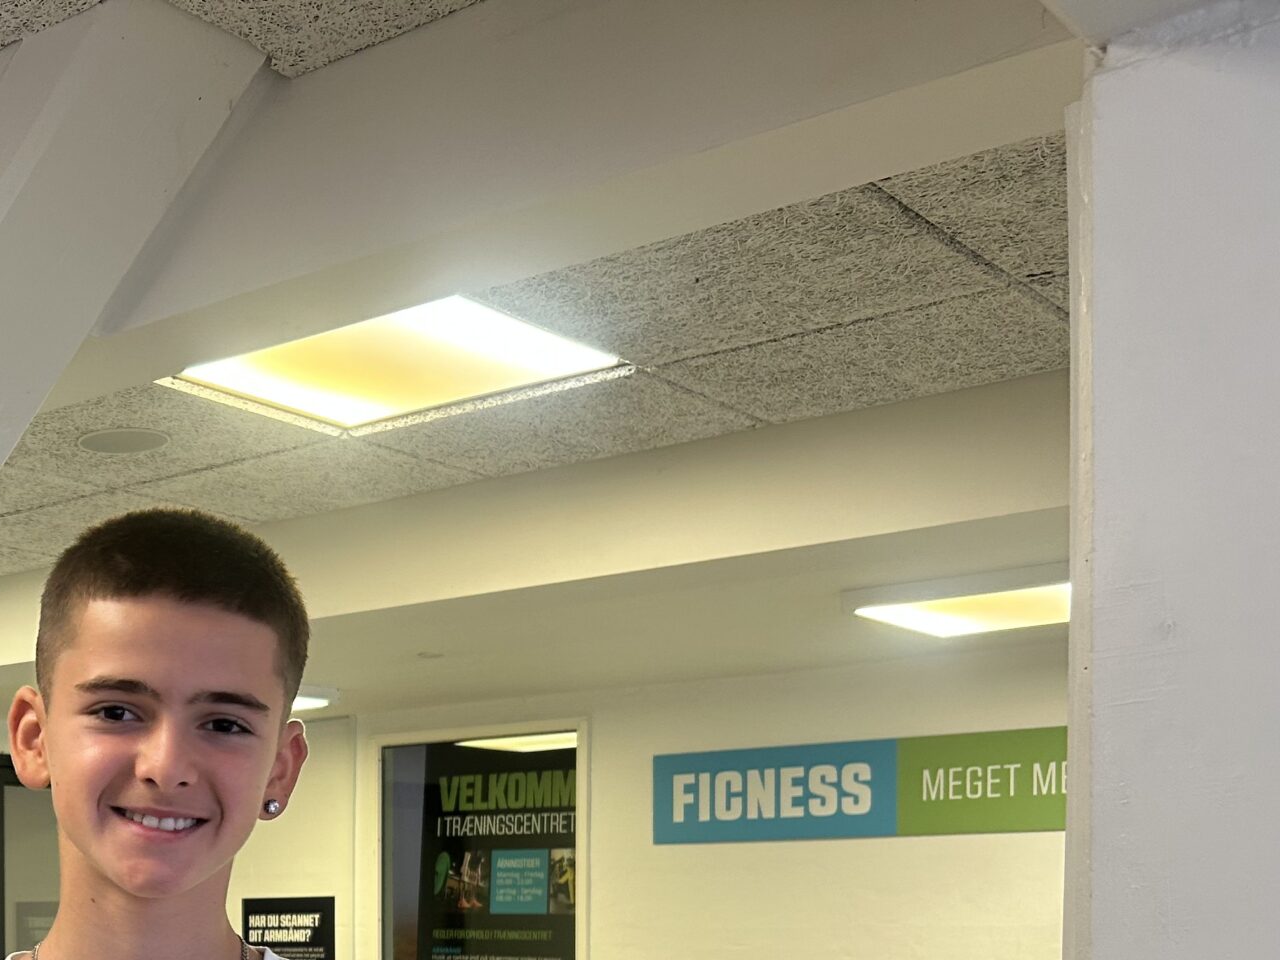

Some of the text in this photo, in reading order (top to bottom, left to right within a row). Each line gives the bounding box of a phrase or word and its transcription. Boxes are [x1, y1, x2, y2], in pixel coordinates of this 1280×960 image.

[439, 769, 576, 812] VELKOMM
[672, 762, 872, 823] FICNESS
[922, 763, 1021, 801] MEGET
[437, 812, 575, 837] I TRÆNINGSCENTRET
[248, 913, 320, 928] HAR DU SCANNET
[248, 926, 311, 943] DIT ARMBÅND?
